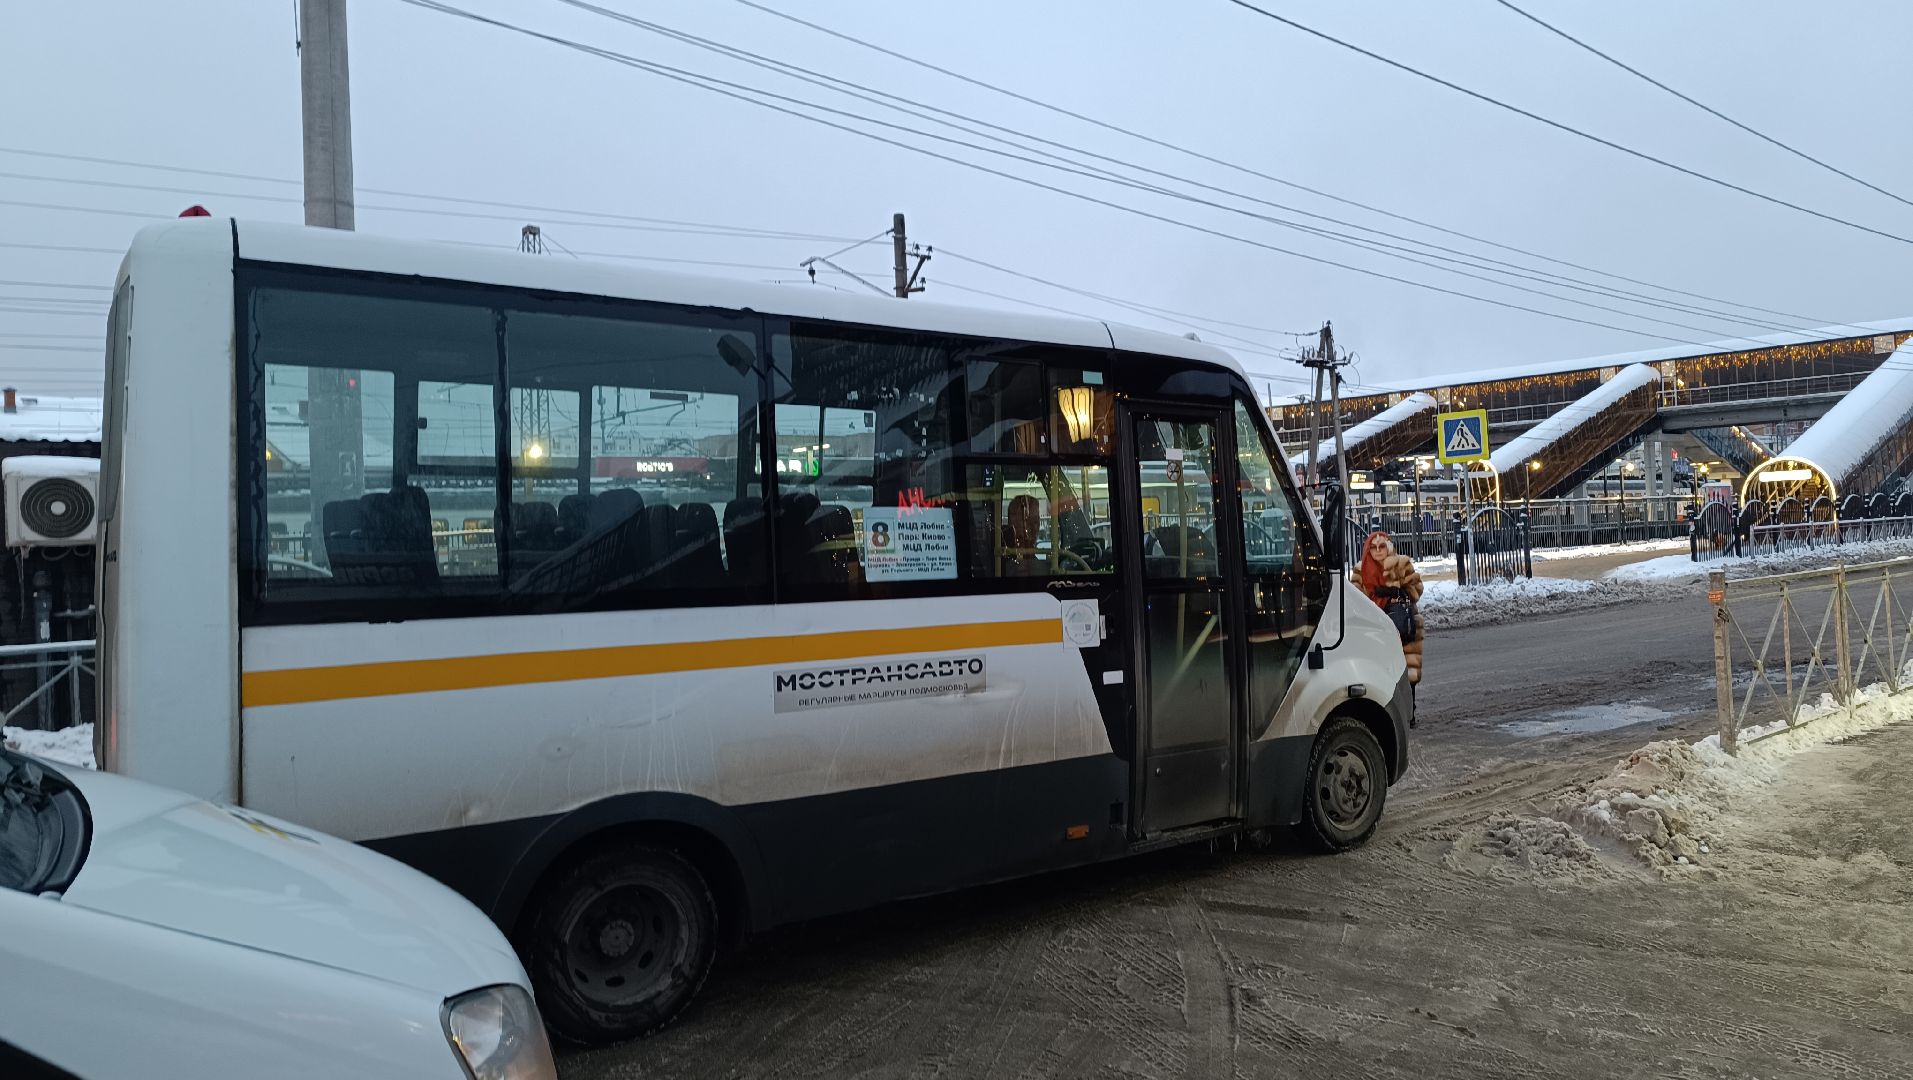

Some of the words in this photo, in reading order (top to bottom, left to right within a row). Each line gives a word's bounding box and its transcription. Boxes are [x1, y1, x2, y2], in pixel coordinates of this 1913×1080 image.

[897, 522, 918, 531] МЦД
[872, 522, 890, 547] 8
[903, 543, 922, 552] МЦД
[776, 658, 984, 692] МОСТРАНСАВТО
[858, 689, 906, 700] МАРШРУТЫ
